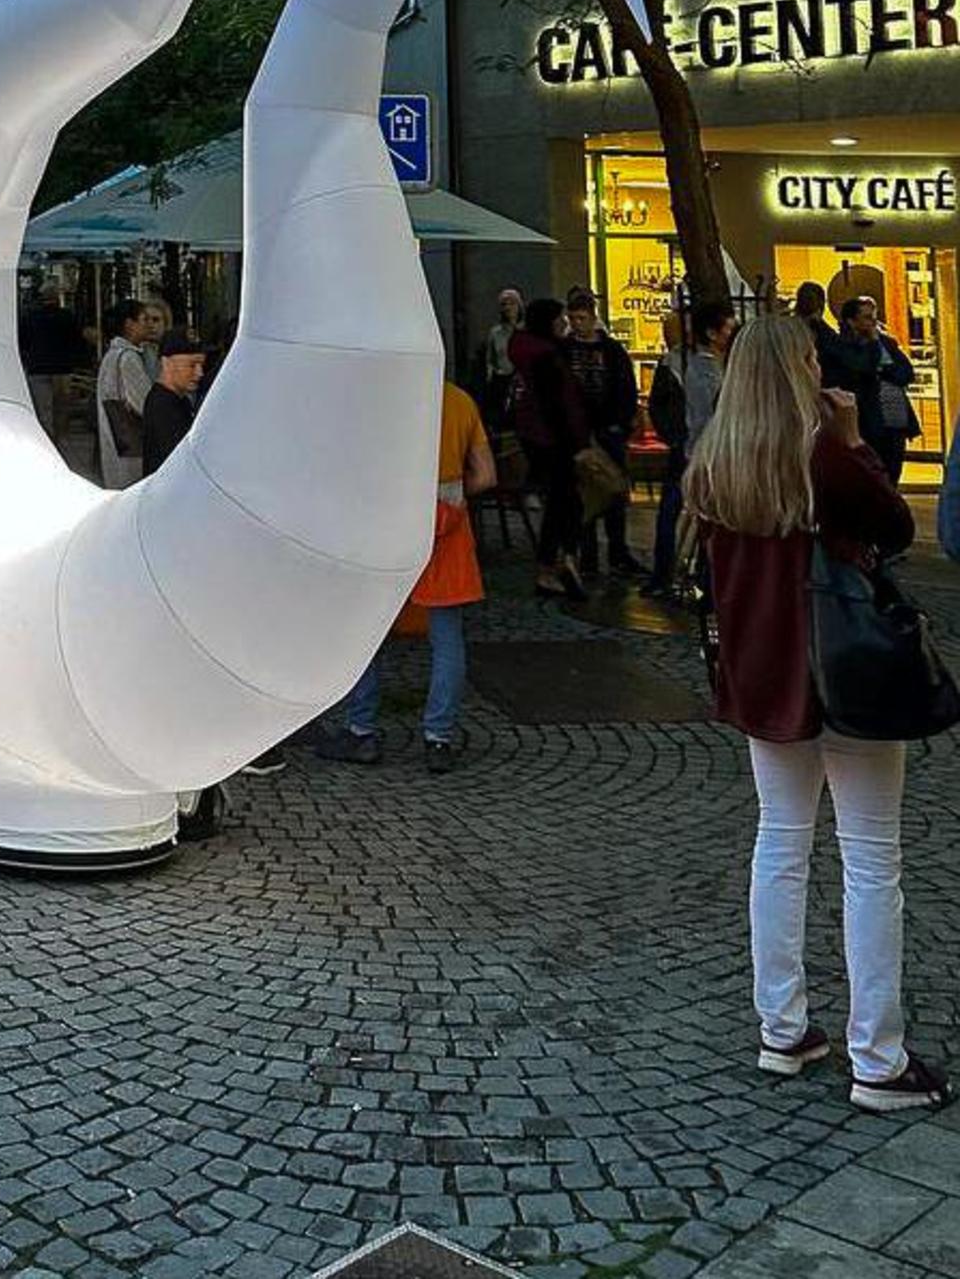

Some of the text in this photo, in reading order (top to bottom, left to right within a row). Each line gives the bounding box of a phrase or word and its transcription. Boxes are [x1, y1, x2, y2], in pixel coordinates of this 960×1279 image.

[778, 170, 955, 210] CITY CAFÉ
[623, 298, 650, 310] CITY
